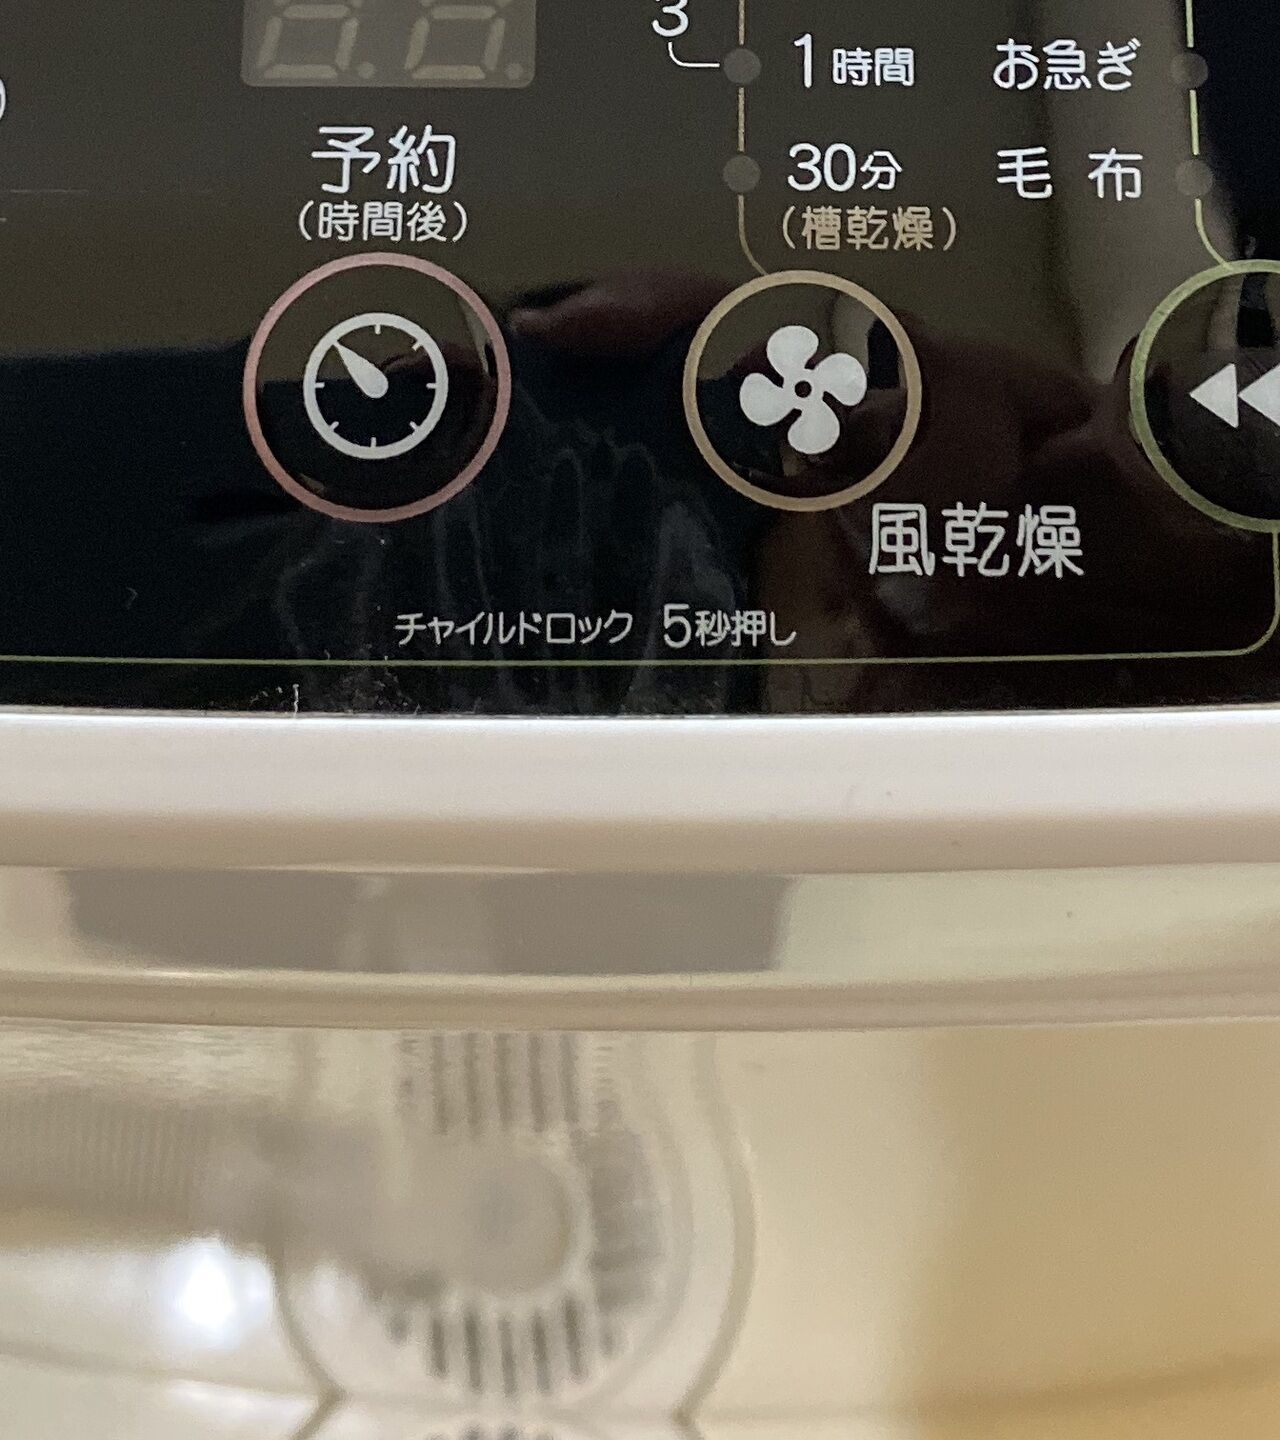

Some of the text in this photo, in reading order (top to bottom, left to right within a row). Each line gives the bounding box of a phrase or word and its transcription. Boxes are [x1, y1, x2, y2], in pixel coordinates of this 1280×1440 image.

[992, 36, 1142, 92] お急ぎ
[310, 123, 457, 195] 予約
[867, 500, 1085, 580] 風乾燥
